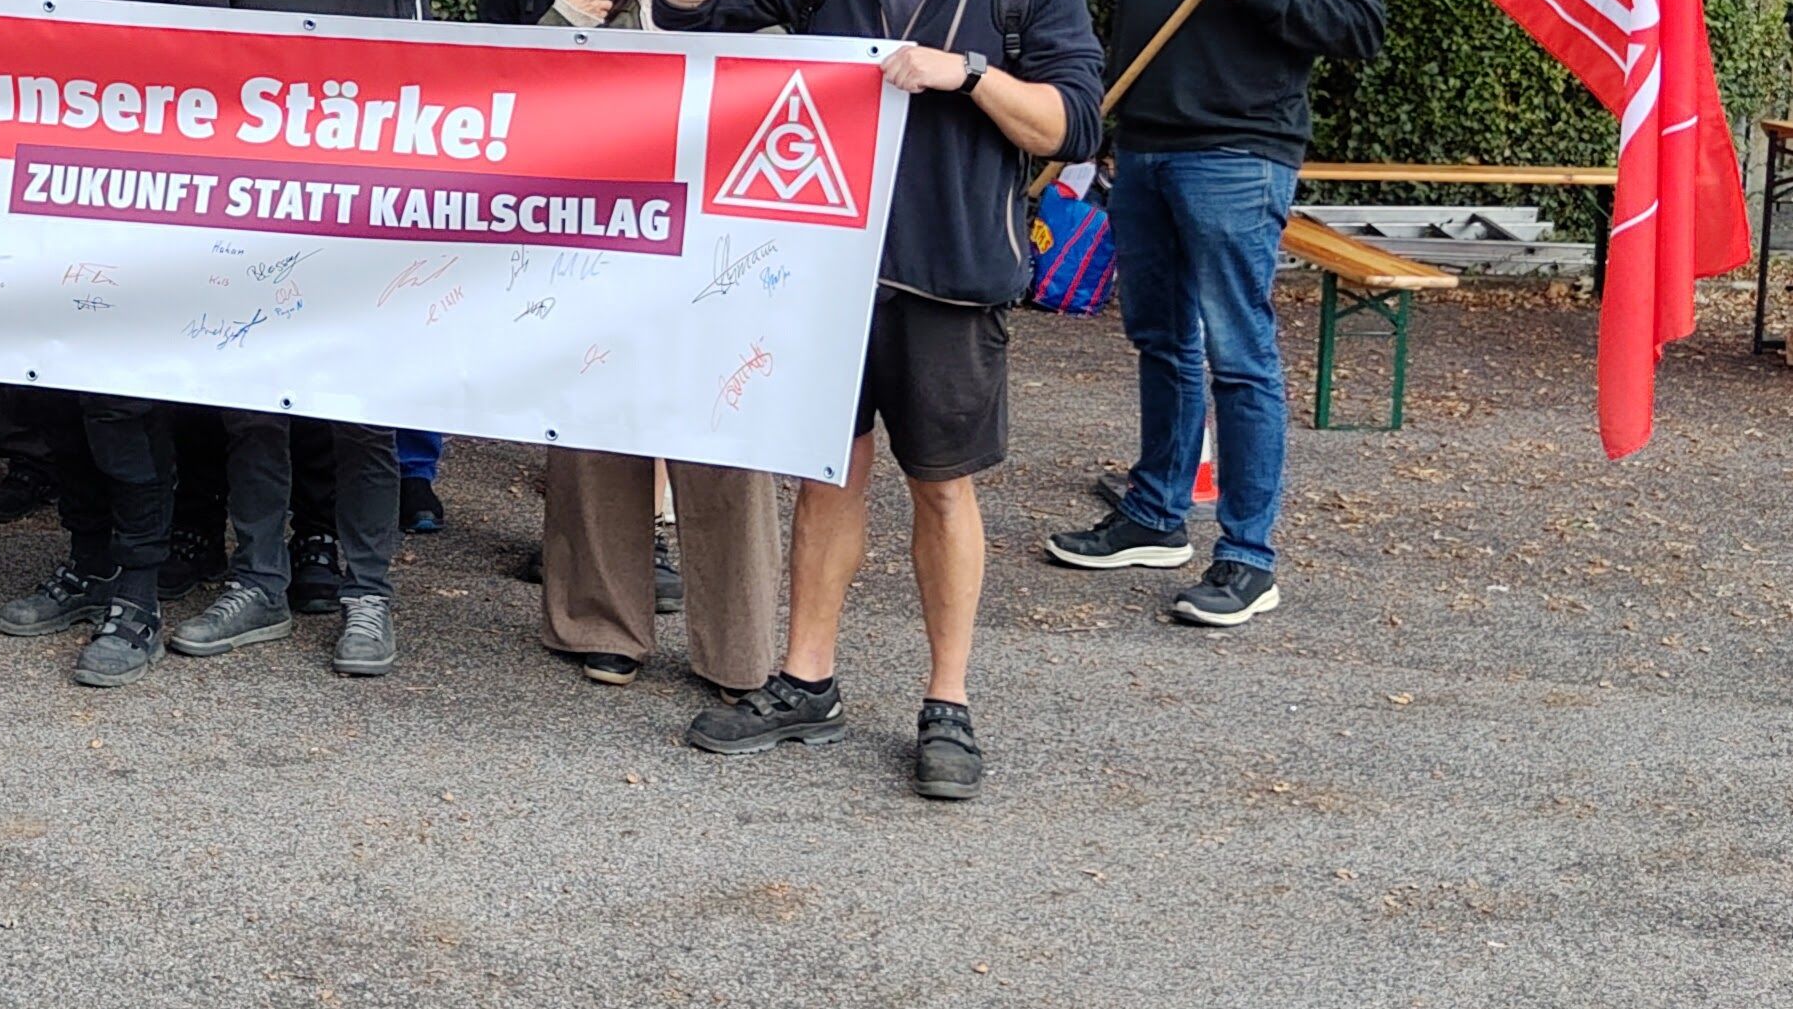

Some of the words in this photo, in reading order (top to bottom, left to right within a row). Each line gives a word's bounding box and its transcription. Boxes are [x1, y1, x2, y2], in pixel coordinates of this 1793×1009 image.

[235, 76, 516, 162] Stärke!
[23, 163, 218, 215] ZUKUNFT
[224, 177, 360, 225] STATT
[369, 184, 671, 242] KAHLSCHLAG
